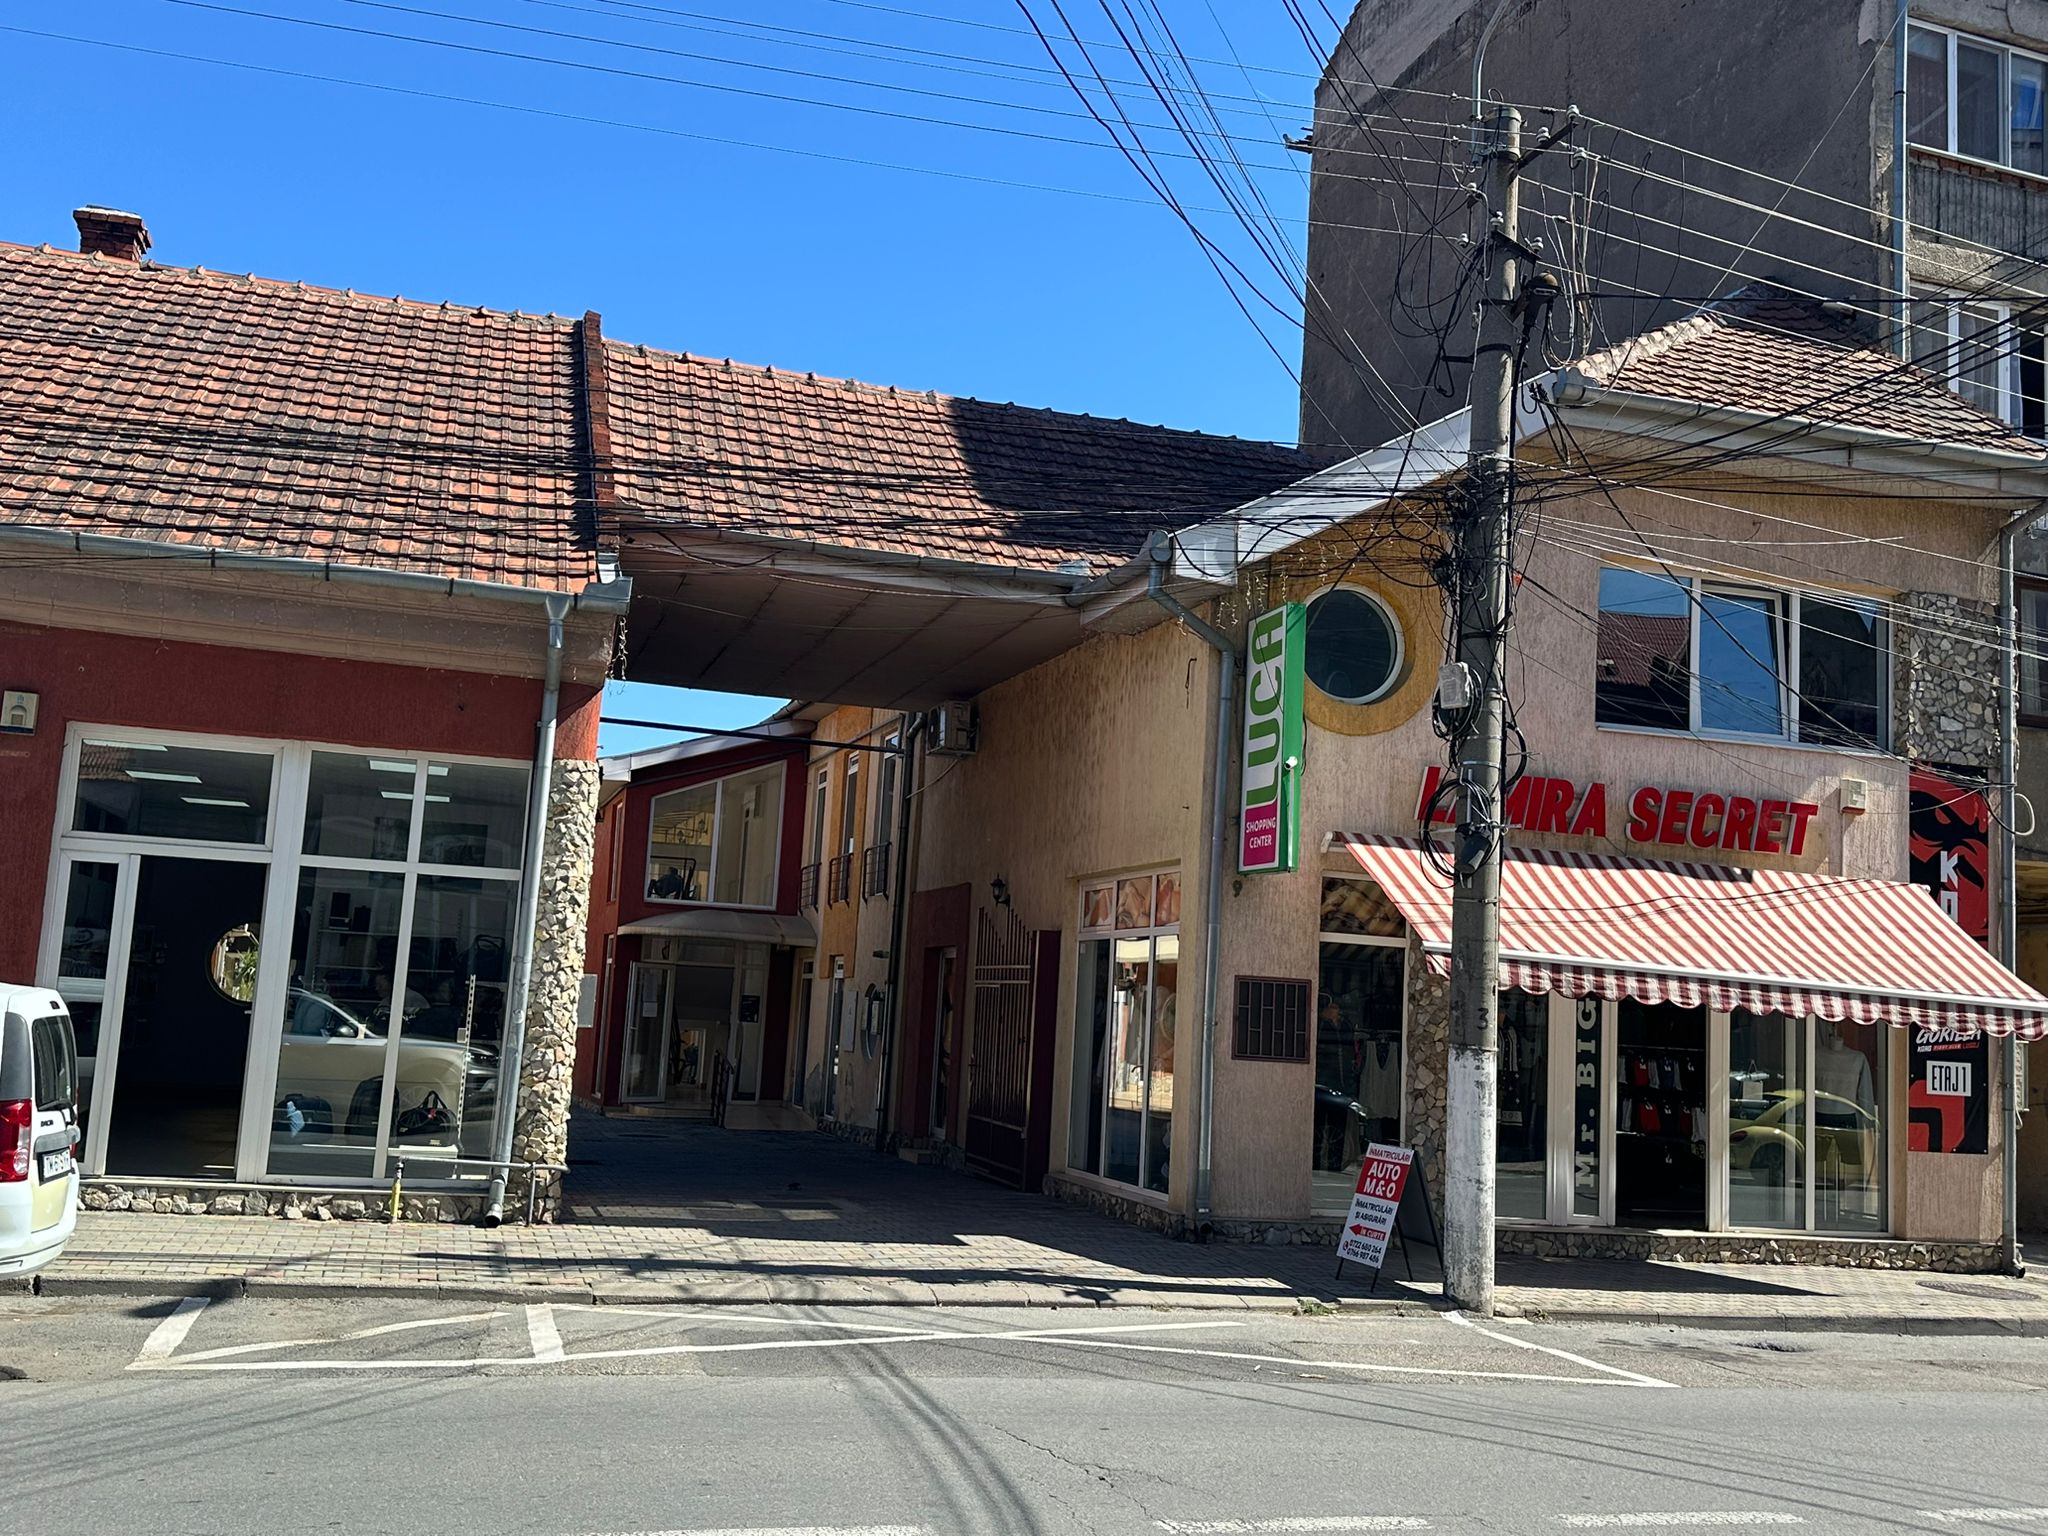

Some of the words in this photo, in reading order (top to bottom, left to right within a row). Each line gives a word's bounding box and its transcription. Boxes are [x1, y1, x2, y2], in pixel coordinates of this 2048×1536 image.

[1246, 610, 1284, 806] LUCA
[1246, 816, 1276, 833] SHOPPING
[1625, 785, 1819, 857] SECRET
[1249, 834, 1272, 849] CENTER
[1576, 998, 1597, 1088] BIG
[1931, 1065, 1959, 1092] ETAJ
[1961, 1066, 1966, 1093] 1
[1575, 1108, 1595, 1188] Mr.
[1368, 1161, 1401, 1181] AUTO
[1366, 1230, 1385, 1240] CURTE
